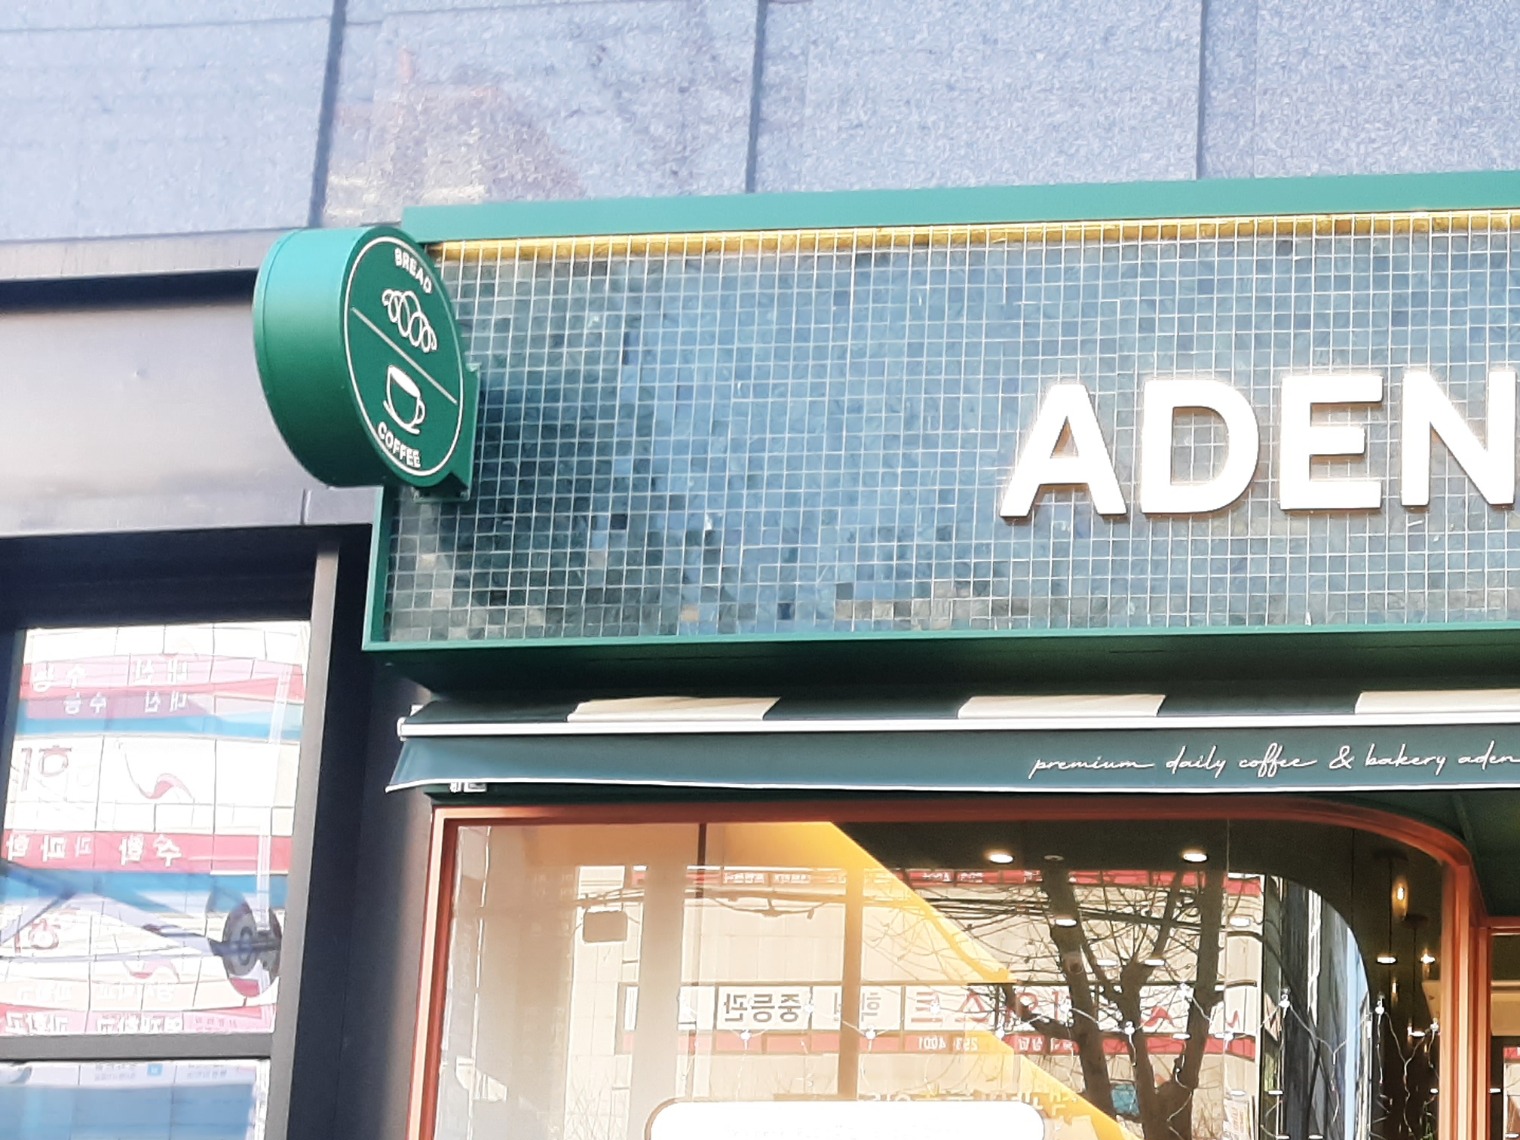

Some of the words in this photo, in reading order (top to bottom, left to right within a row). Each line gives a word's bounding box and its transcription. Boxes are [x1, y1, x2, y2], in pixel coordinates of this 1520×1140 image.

[394, 248, 433, 295] BREAD
[377, 421, 421, 468] COFFEE
[1000, 370, 1516, 520] ADEN
[1028, 755, 1155, 779] premium
[1166, 745, 1226, 778] daily
[1238, 743, 1317, 777] coffee
[1329, 745, 1353, 769] &
[1365, 743, 1446, 775] bakery
